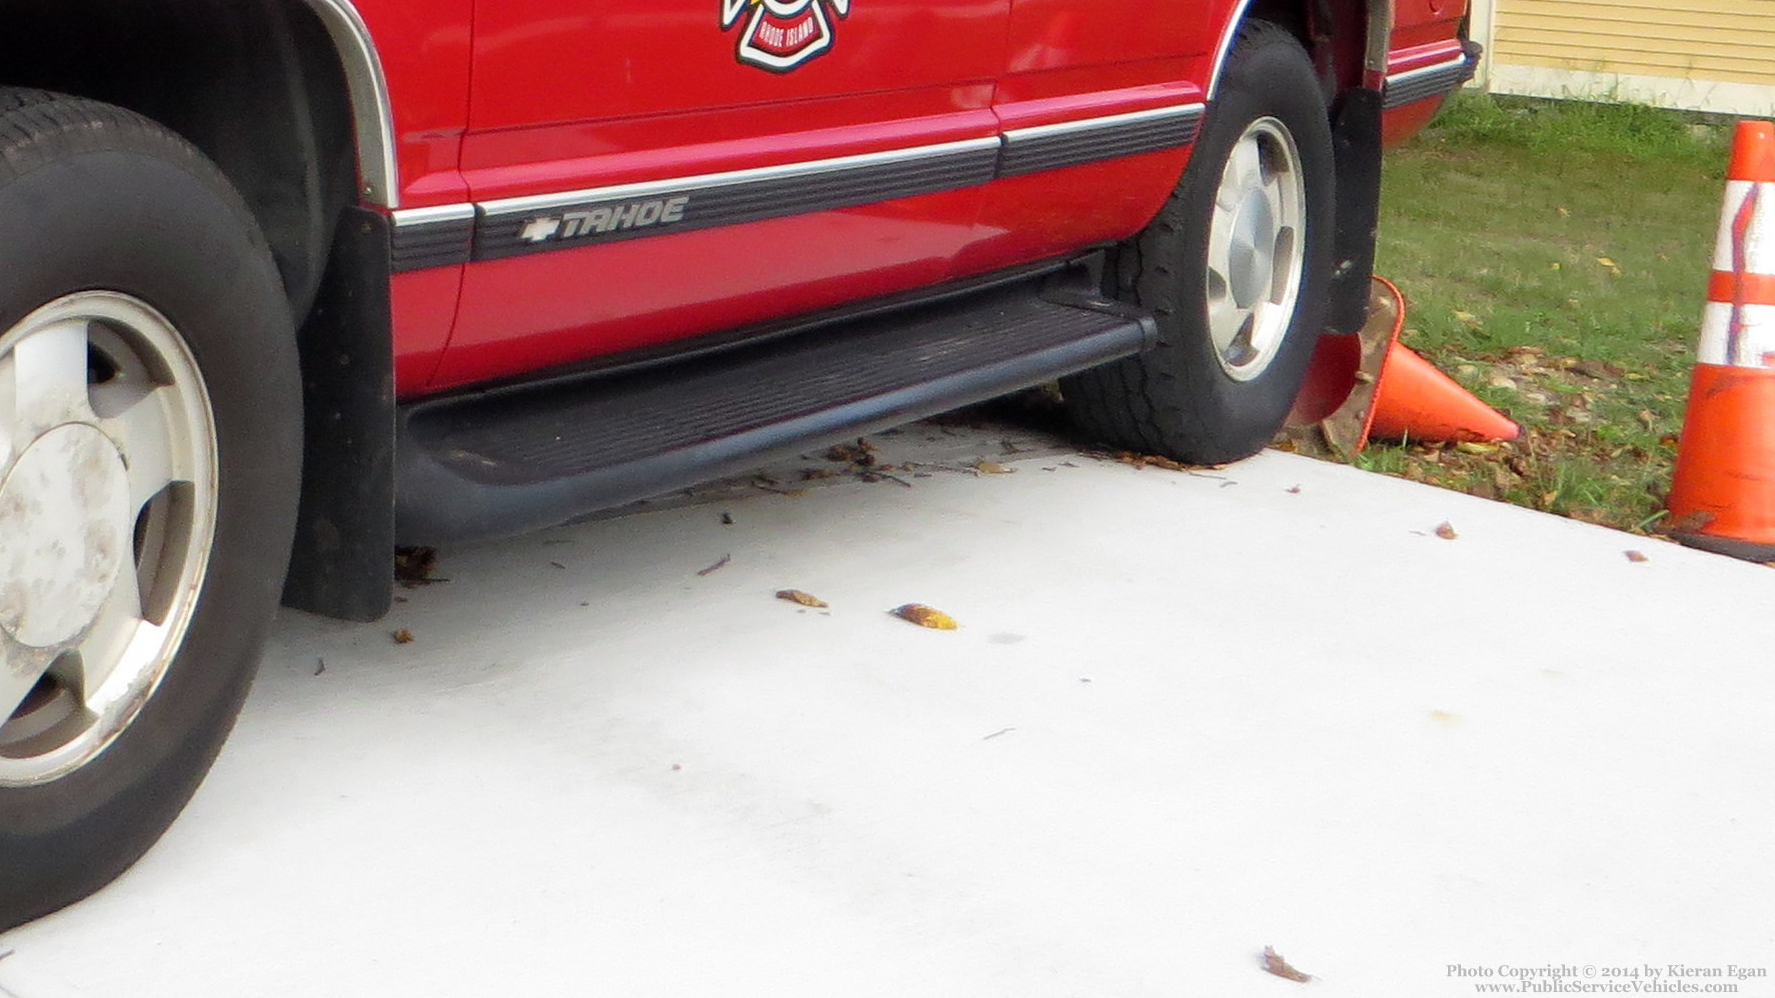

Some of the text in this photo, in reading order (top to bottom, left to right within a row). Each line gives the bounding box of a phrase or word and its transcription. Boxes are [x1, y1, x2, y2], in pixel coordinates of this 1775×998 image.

[758, 16, 814, 48] RHODE ISLAND
[562, 195, 690, 238] TAHOE
